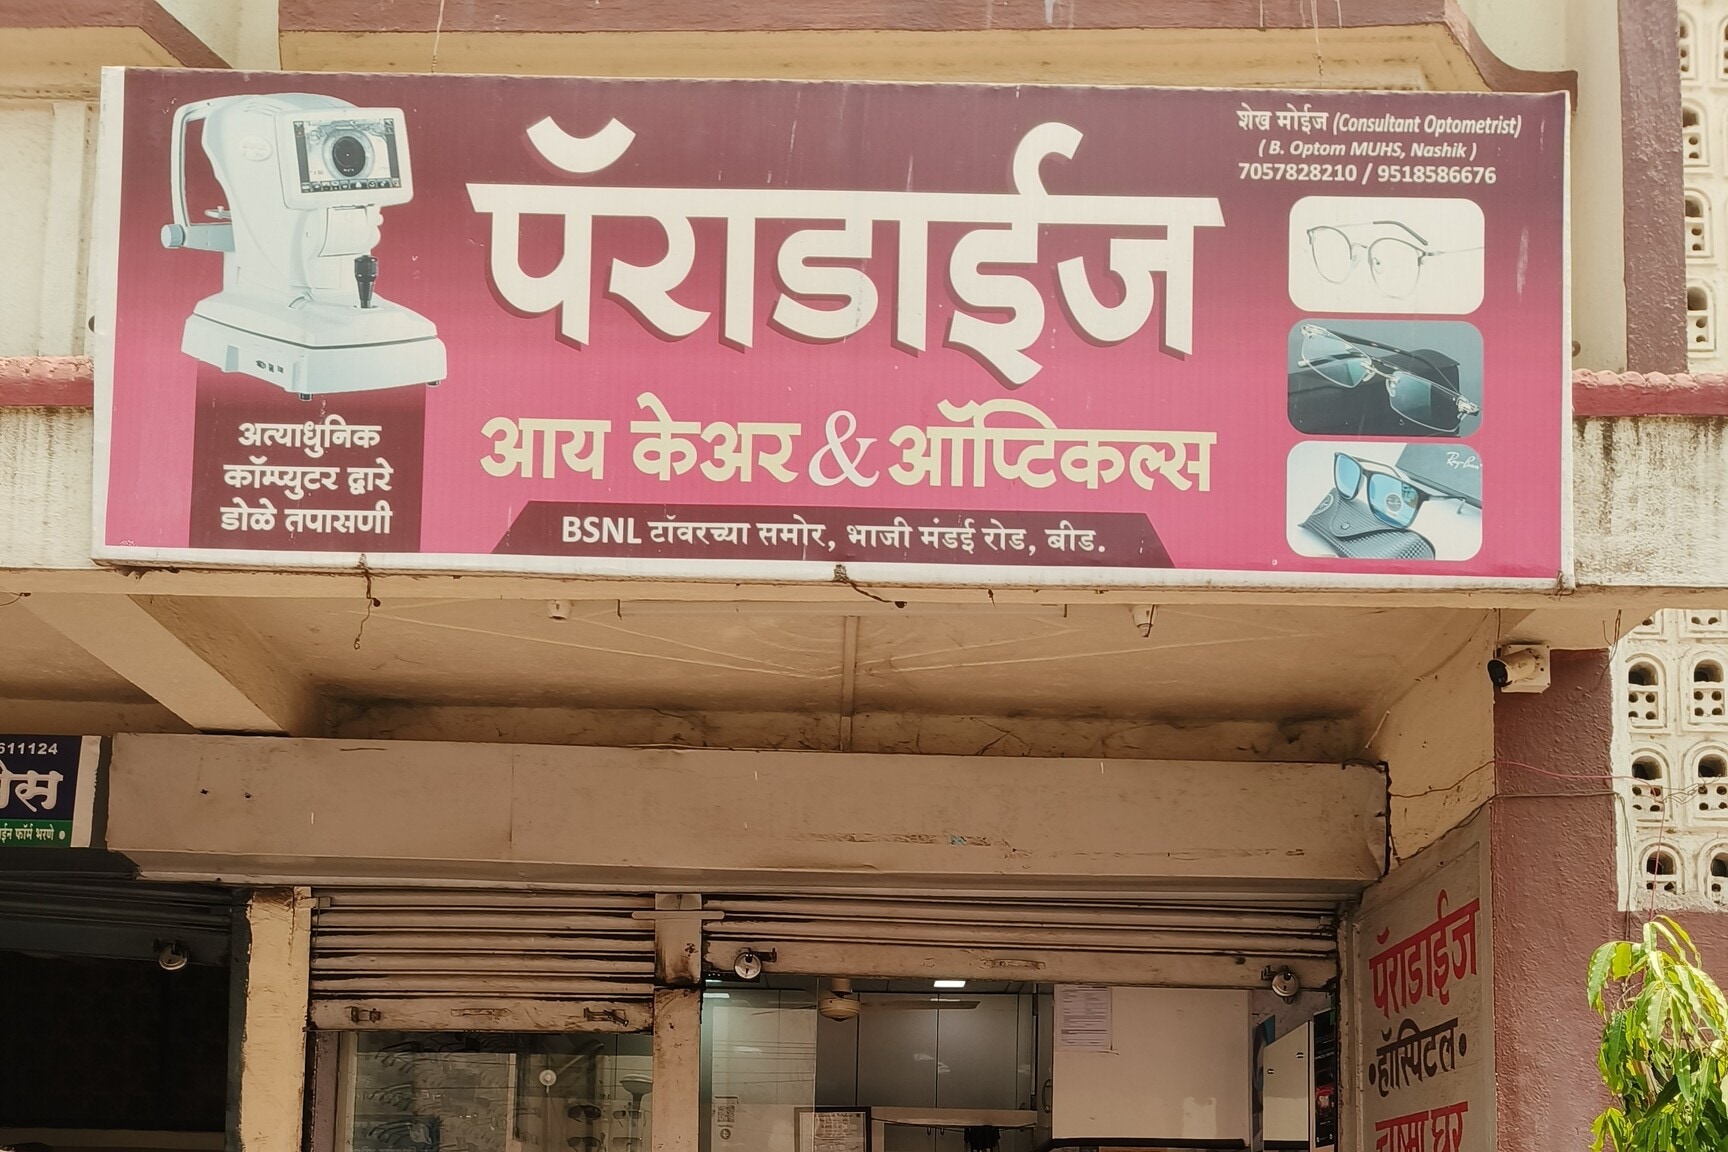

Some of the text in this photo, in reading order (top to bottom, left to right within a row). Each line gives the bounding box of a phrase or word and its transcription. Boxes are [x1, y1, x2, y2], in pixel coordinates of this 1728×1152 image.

[1236, 103, 1522, 138] शेख मोईज (Consultant Optometrist)
[1269, 140, 1285, 155] B.
[1290, 141, 1345, 158] Optom
[1350, 142, 1406, 159] MUHS,
[1410, 143, 1467, 158] Nashik
[1238, 163, 1357, 182] 7057828210
[1377, 165, 1497, 184] 9518586676
[466, 115, 1225, 386] पॅराडाईज
[237, 414, 382, 458] अत्याधुनिक
[480, 391, 1218, 493] आय केअर & ऑप्टिकल्स
[223, 455, 394, 500] कॉम्प्युटर द्वारे
[220, 497, 393, 534] डोळे तपासणी
[562, 513, 1106, 556] BSNL टॉवरच्या समोर, भाजी मंडई रोड, बीड.
[1376, 1017, 1458, 1097] हॉस्पिटल
